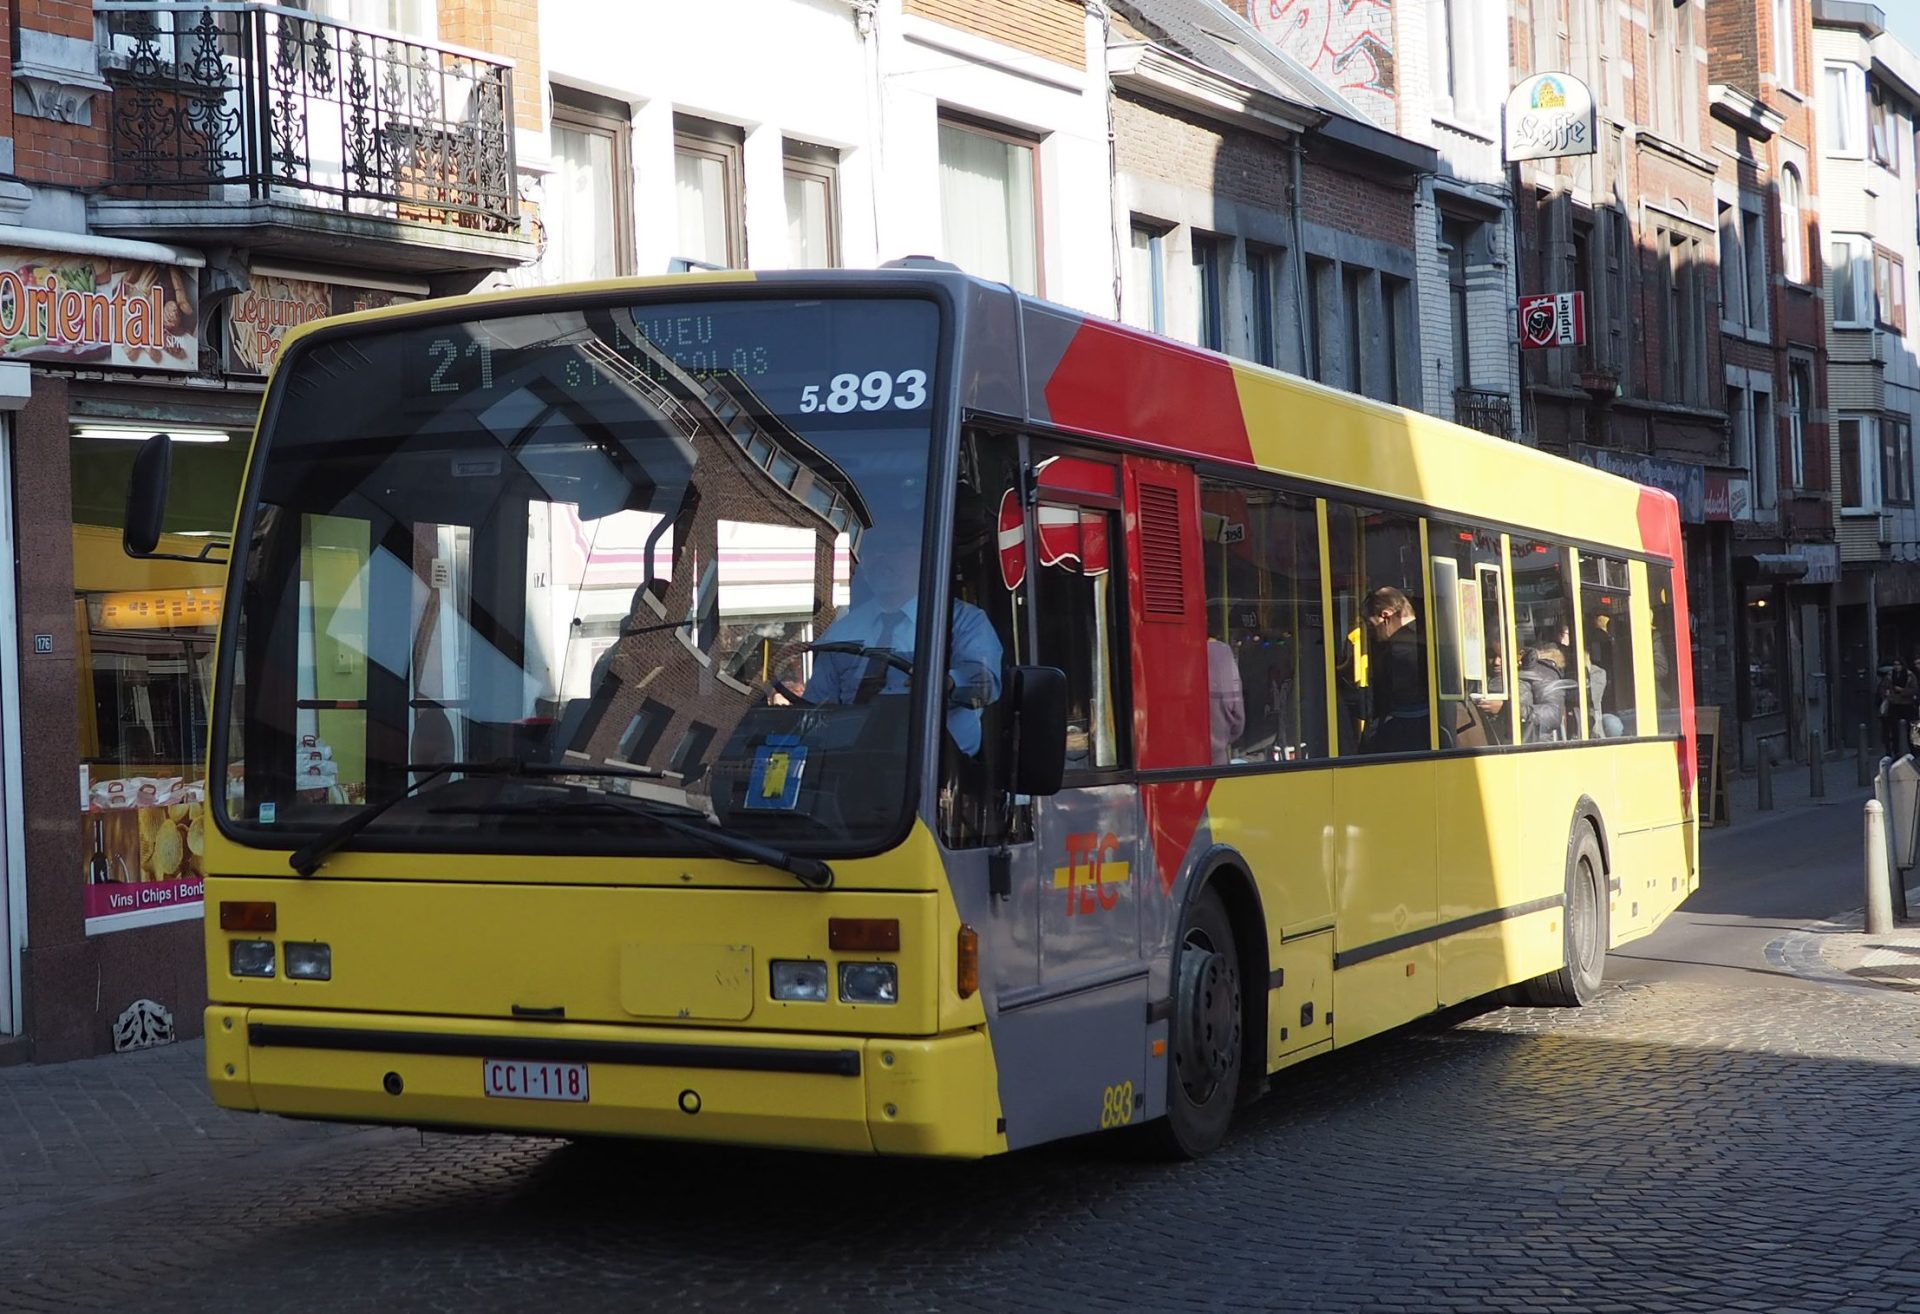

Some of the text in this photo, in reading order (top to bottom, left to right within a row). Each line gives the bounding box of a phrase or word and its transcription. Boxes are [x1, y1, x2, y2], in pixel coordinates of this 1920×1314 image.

[1513, 111, 1586, 152] Leffe
[0, 270, 164, 348] Oriental
[234, 291, 327, 331] Légumes
[1560, 296, 1571, 342] Jupiler
[428, 336, 493, 392] 21
[633, 346, 768, 382] NICOLAS
[38, 637, 50, 650] 176
[1065, 831, 1120, 917] TEC
[110, 894, 133, 908] Vins
[142, 887, 172, 904] Chips
[1101, 1080, 1132, 1129] 893
